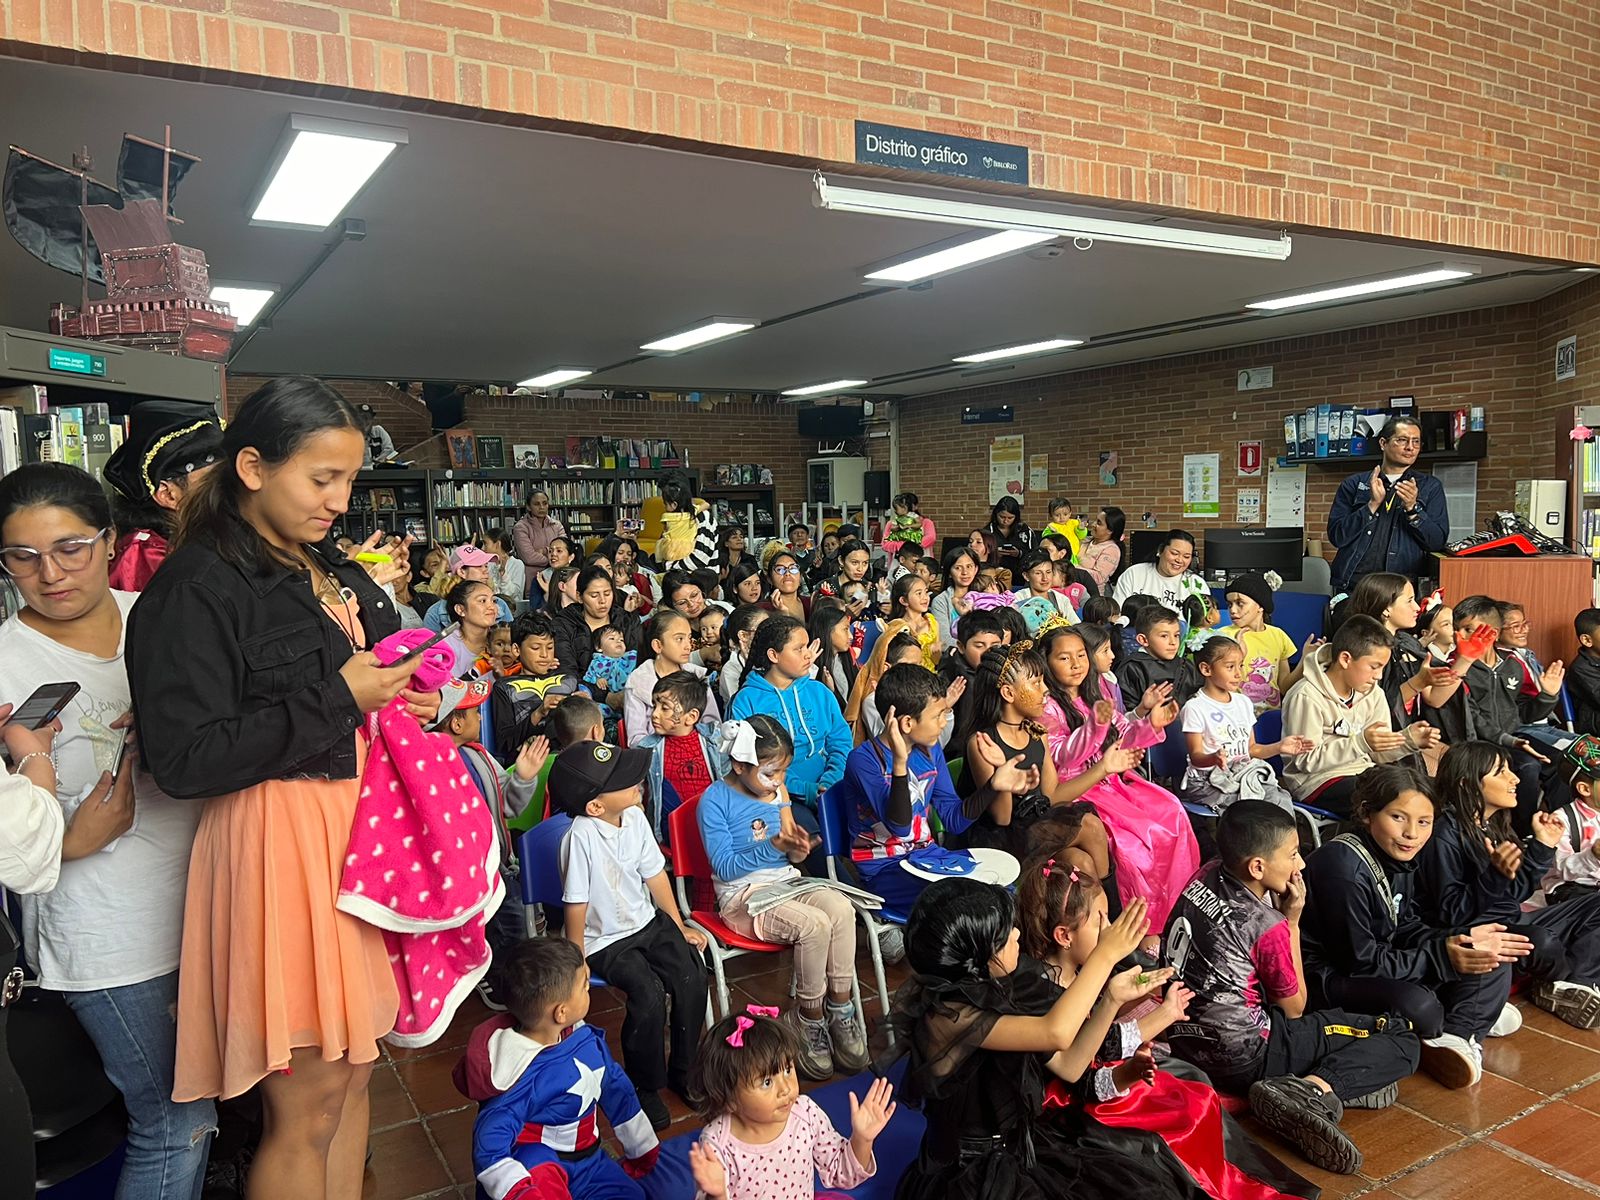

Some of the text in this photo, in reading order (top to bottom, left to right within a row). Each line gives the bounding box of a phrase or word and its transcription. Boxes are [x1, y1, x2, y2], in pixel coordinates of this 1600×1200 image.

[865, 134, 968, 166] Distrito gráfico
[92, 433, 105, 442] 900
[1166, 916, 1193, 979] 9
